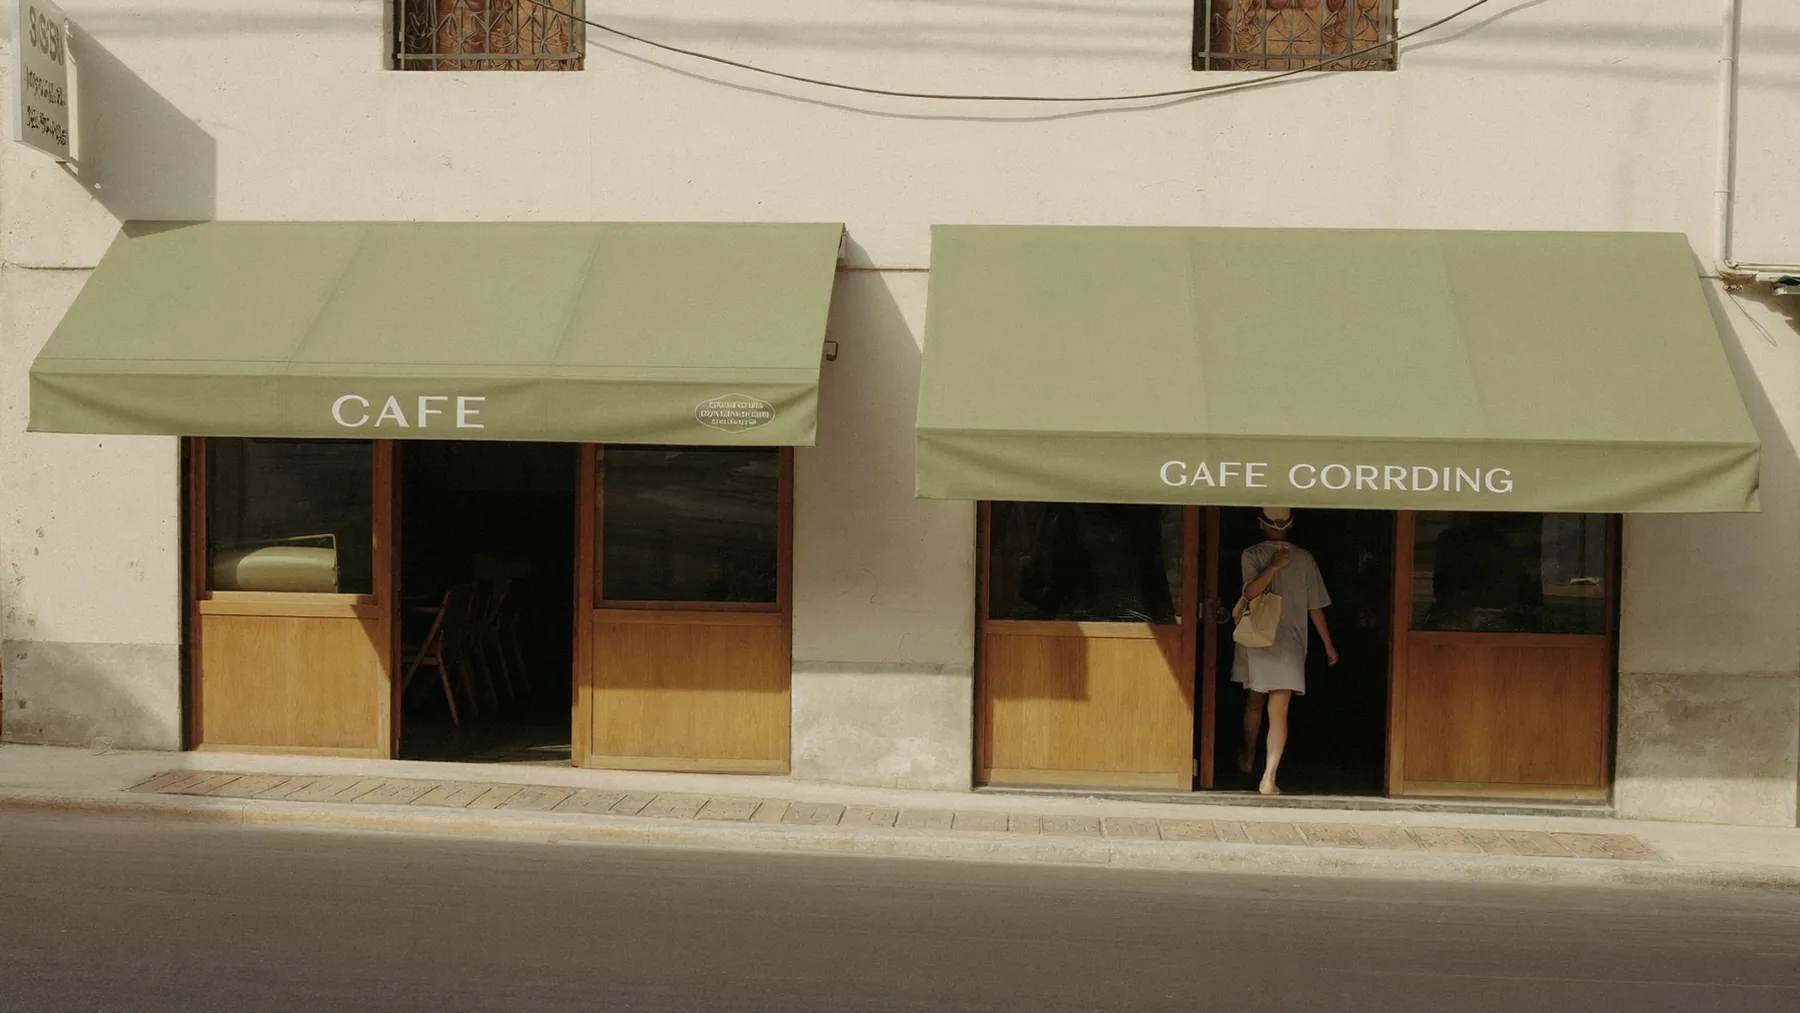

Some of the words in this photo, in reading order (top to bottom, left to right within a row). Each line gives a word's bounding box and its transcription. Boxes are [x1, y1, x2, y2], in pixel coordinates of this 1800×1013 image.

[331, 394, 486, 429] CAFE
[1159, 460, 1268, 488] GAFE
[1288, 463, 1514, 494] CORRDING
